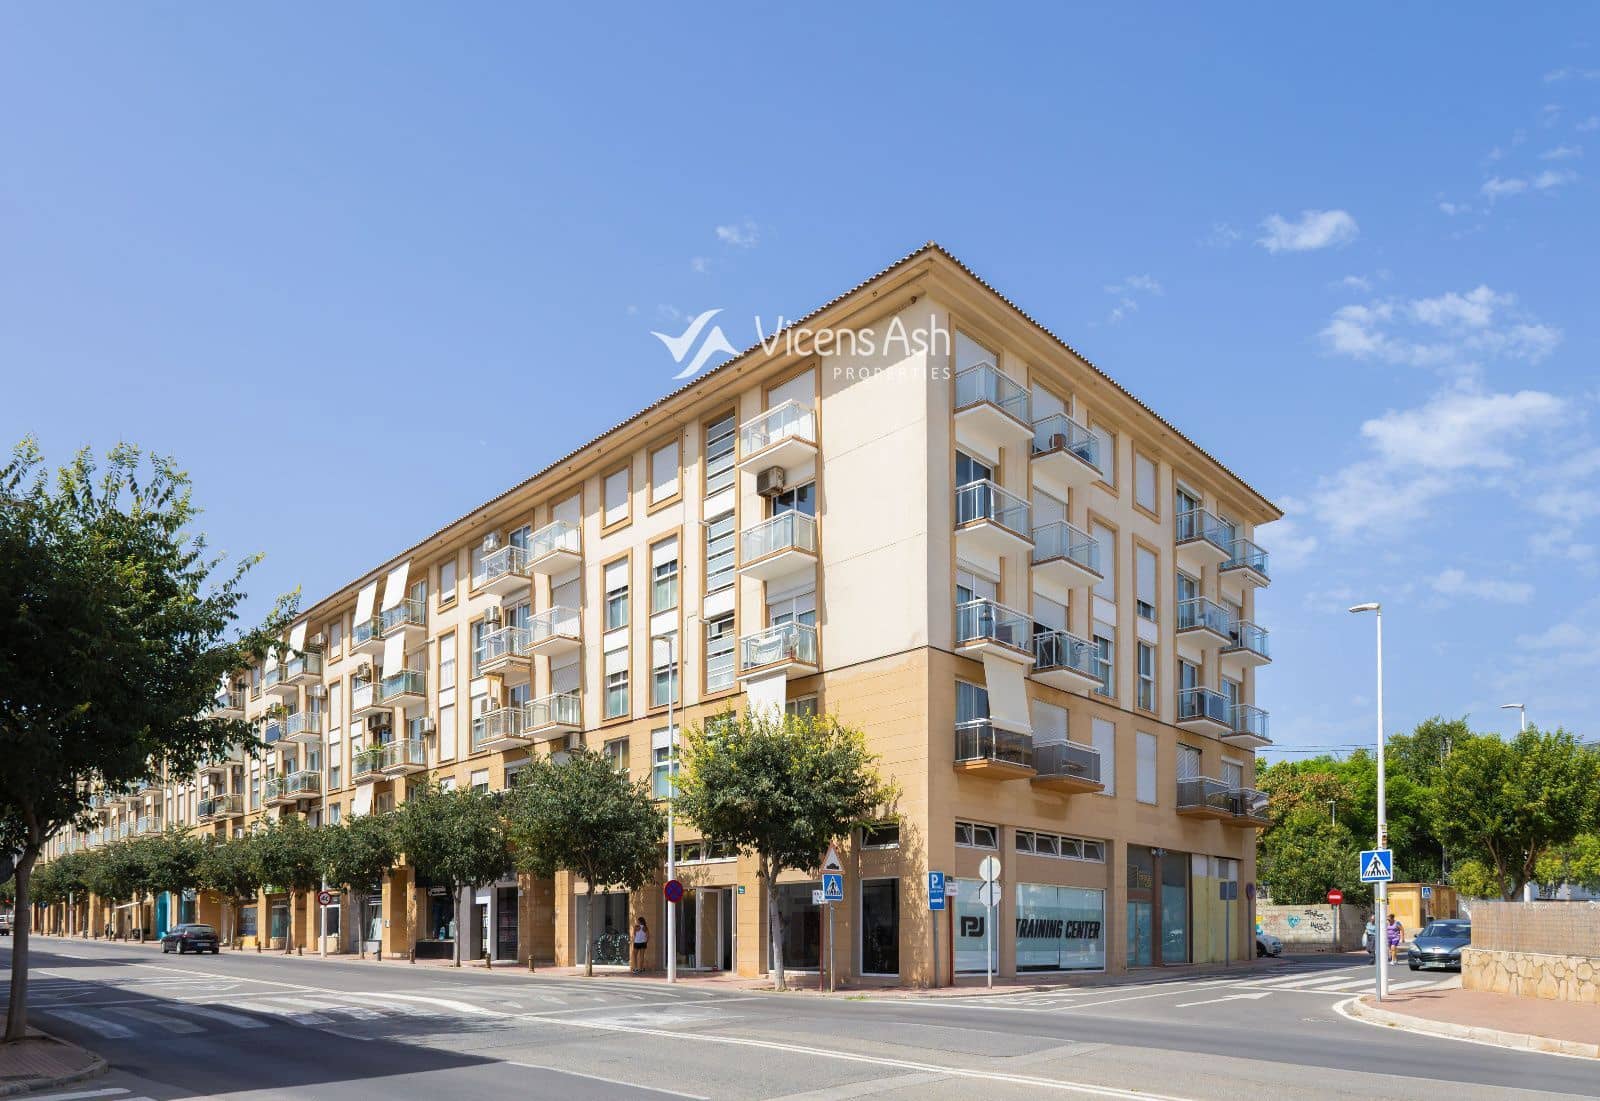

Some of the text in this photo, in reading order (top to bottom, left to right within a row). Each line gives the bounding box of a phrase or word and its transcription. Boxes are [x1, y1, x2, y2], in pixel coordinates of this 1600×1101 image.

[931, 874, 939, 888] P
[1016, 918, 1100, 939] TRAINING CENTER
